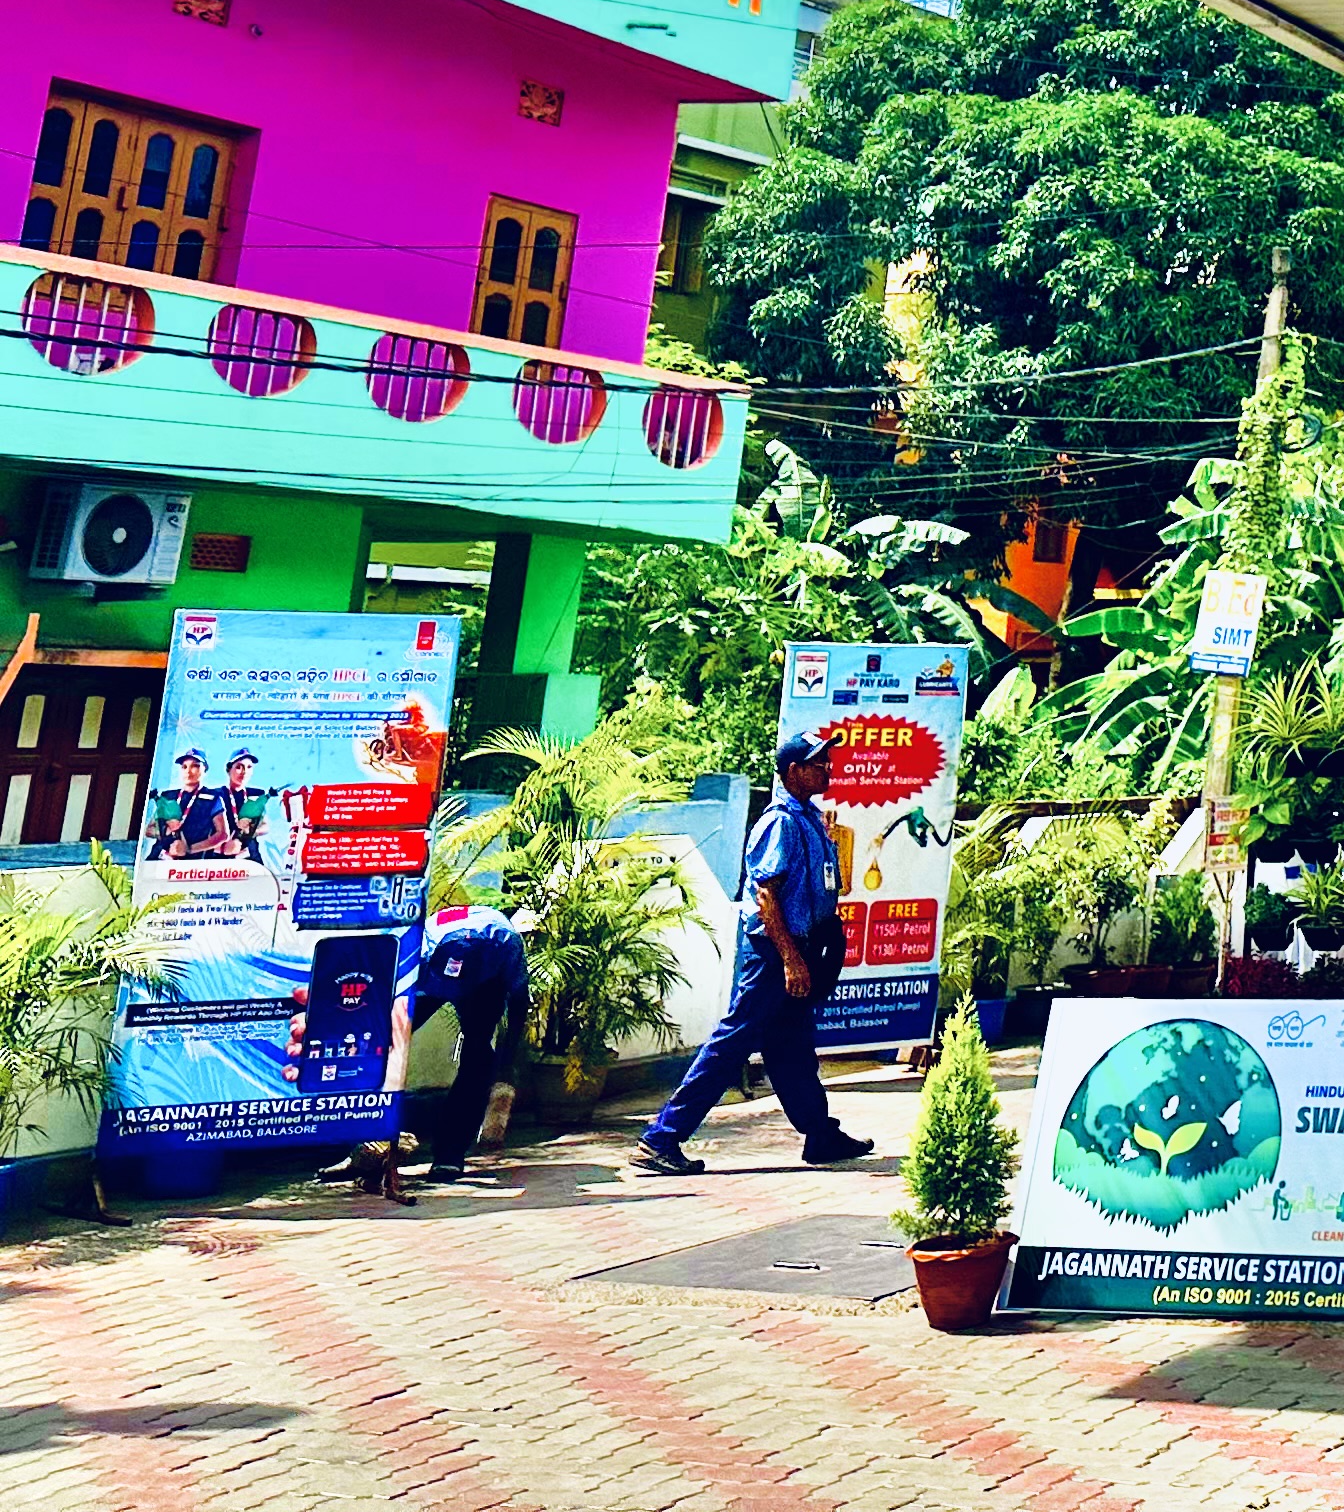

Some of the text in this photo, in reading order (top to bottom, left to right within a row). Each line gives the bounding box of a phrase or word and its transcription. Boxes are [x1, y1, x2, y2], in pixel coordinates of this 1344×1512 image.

[1212, 626, 1253, 647] SIMT
[859, 678, 875, 689] PAY
[876, 678, 900, 689] KARO
[831, 727, 913, 748] OFFER
[843, 761, 883, 775] only
[888, 902, 919, 919] FREE
[903, 922, 931, 935] Petrol
[901, 942, 929, 956] Petrol
[341, 984, 367, 996] HP
[834, 979, 930, 1001] SERVICE STATION
[342, 996, 361, 1006] PAY
[238, 1098, 312, 1116] SERVICE
[315, 1092, 393, 1110] STATION
[186, 1124, 317, 1143] AZIMABAD, BALASORE
[1311, 1230, 1344, 1243] CLEAN
[1037, 1250, 1172, 1281] JAGANNATH
[1173, 1256, 1260, 1283] SERVICE
[1153, 1285, 1181, 1306] (An
[1184, 1287, 1213, 1304] ISO
[1215, 1288, 1252, 1305] 9001
[1264, 1290, 1300, 1307] 2015
